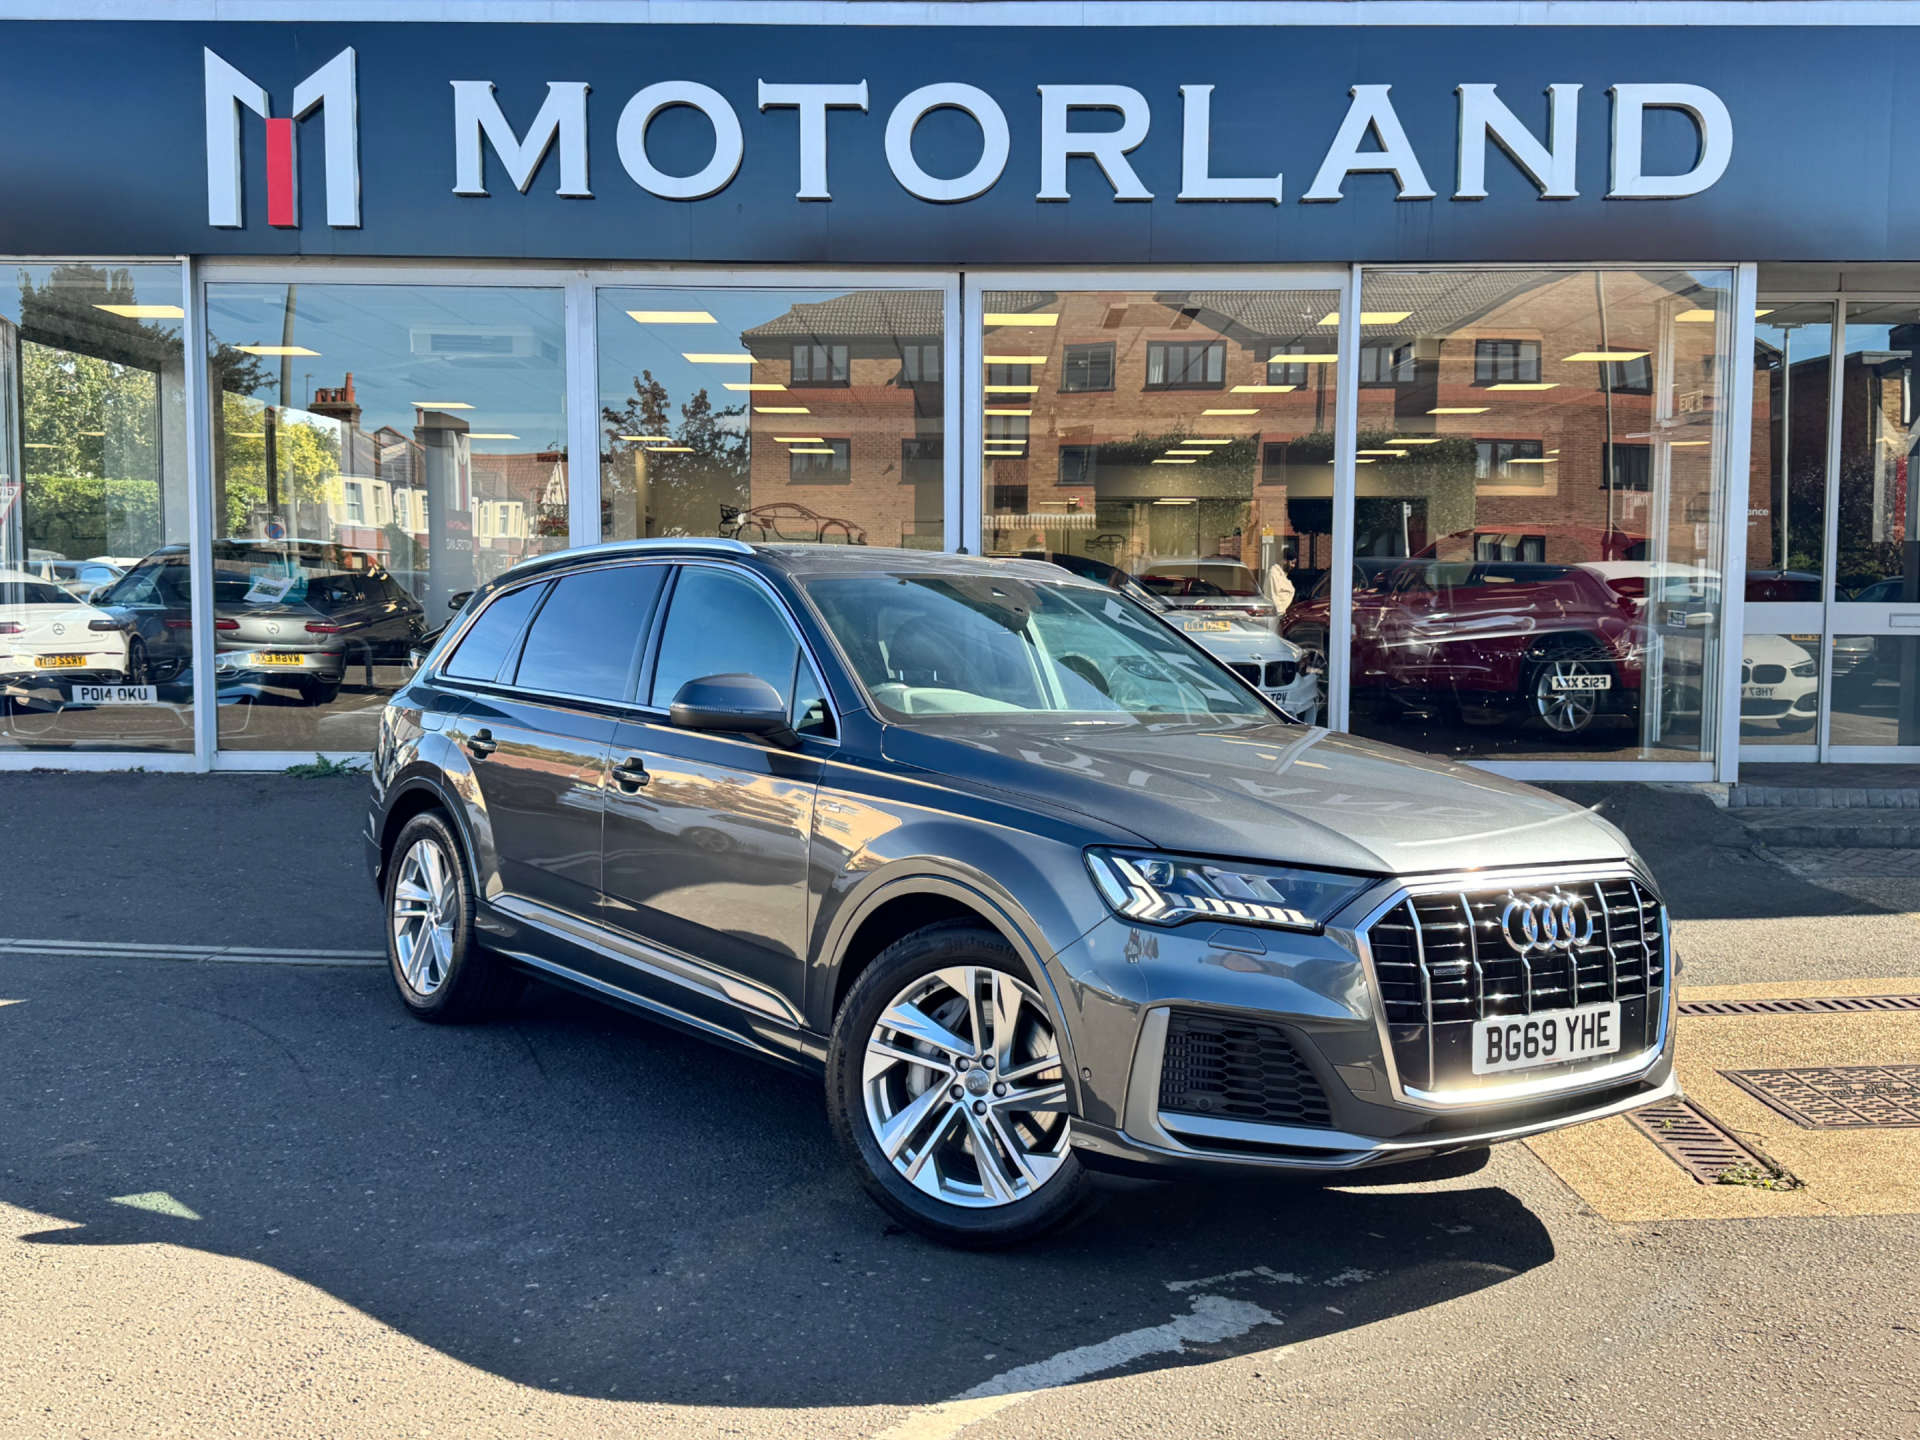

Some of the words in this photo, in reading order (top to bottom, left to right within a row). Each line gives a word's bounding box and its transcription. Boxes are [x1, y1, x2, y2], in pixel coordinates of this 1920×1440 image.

[449, 78, 1733, 202] MOTORLAND
[117, 687, 148, 701] OKU
[1486, 1019, 1557, 1065] BG69
[1565, 1011, 1610, 1052] YHE
